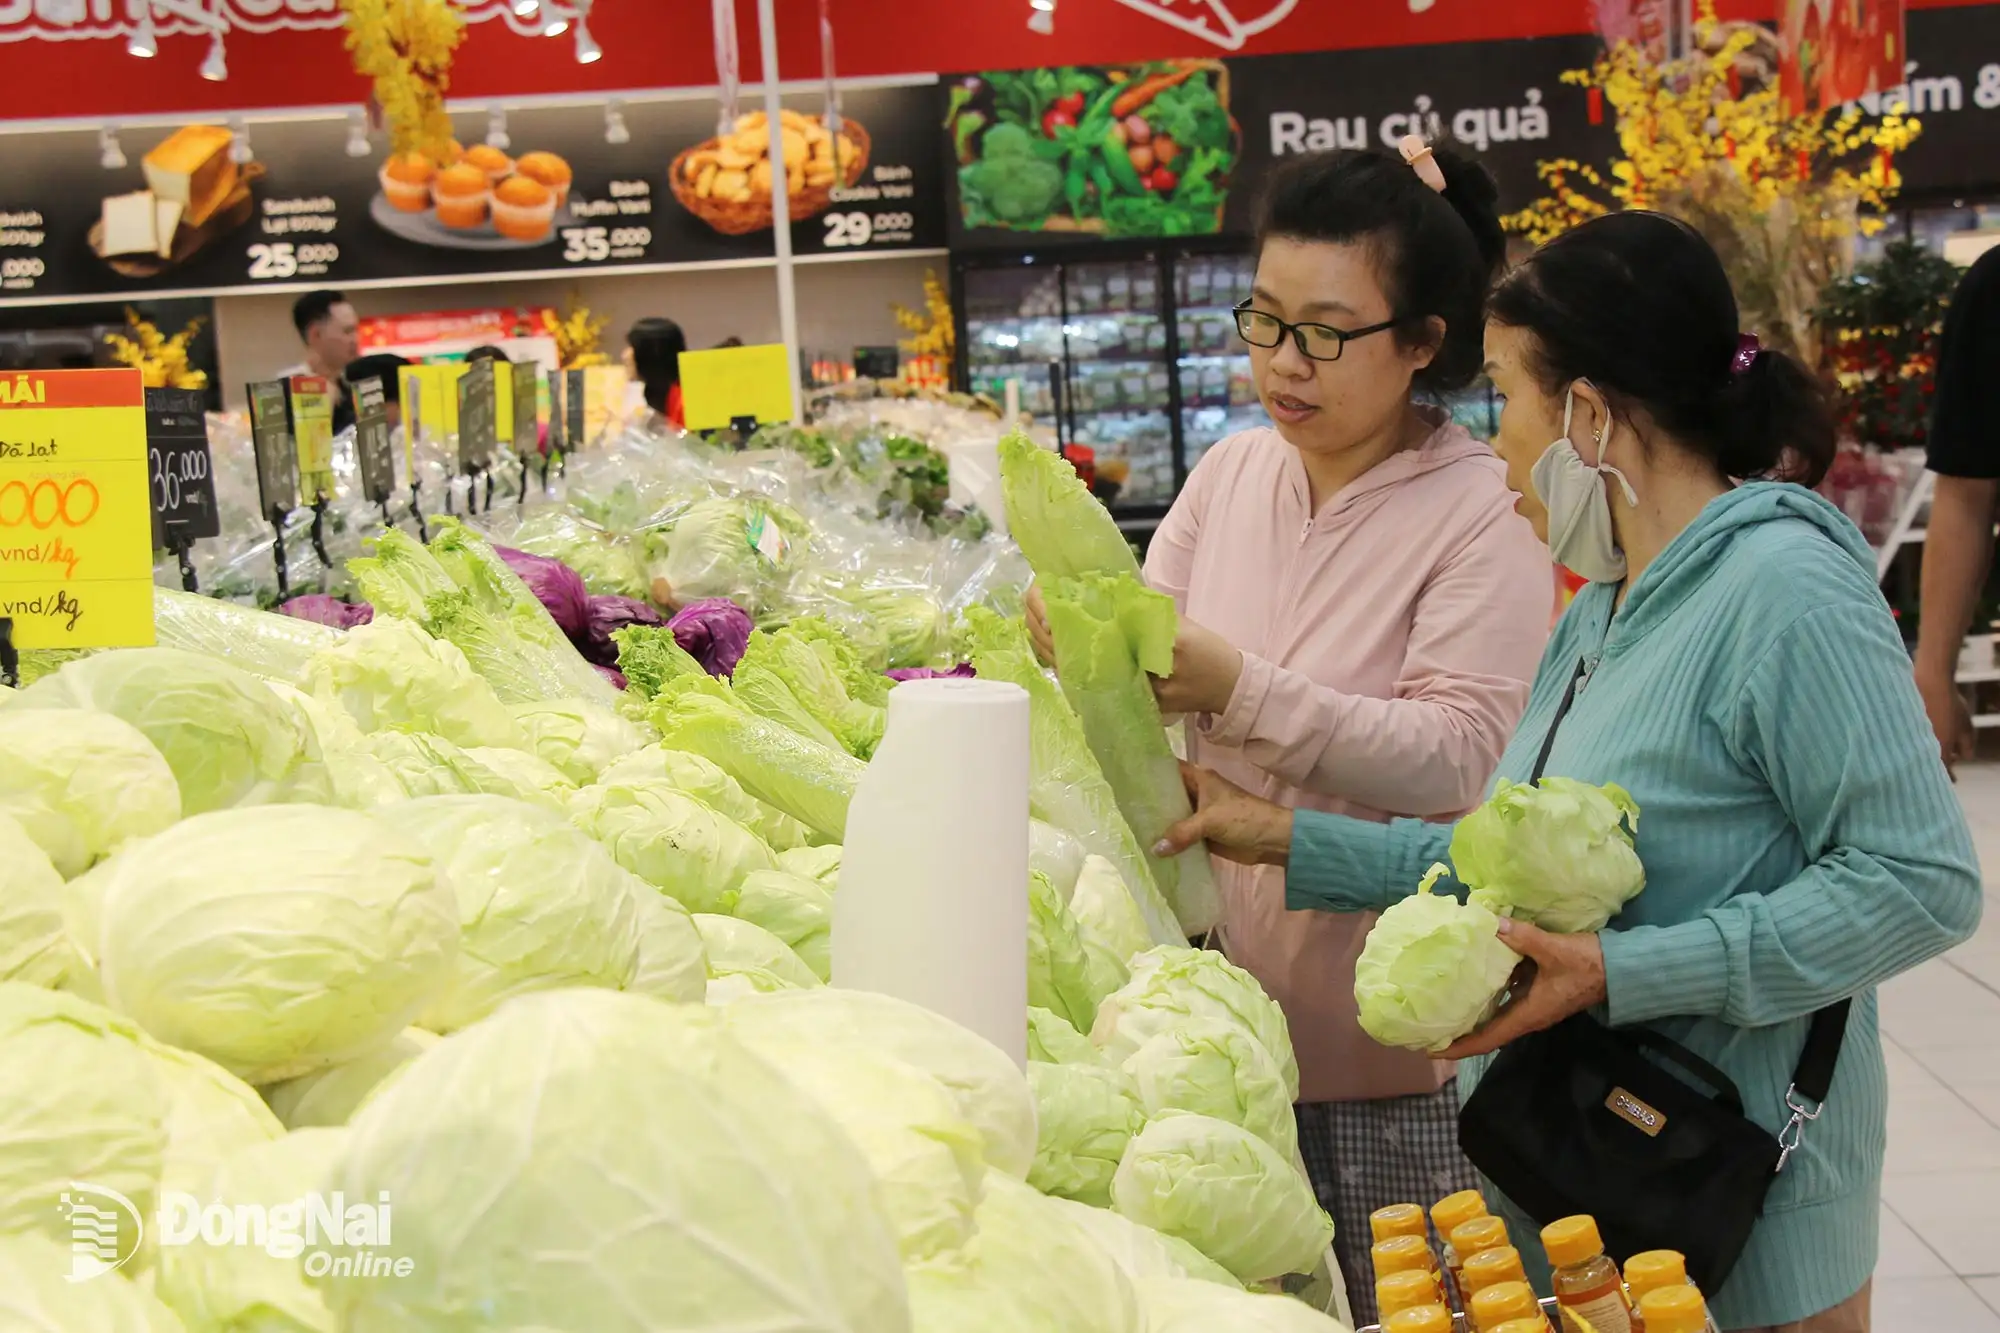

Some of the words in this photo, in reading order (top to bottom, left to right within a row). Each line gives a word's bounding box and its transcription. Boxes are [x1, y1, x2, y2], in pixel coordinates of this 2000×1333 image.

[1269, 111, 1368, 156] Rau
[1452, 87, 1547, 152] quả
[150, 448, 207, 512] 36.000
